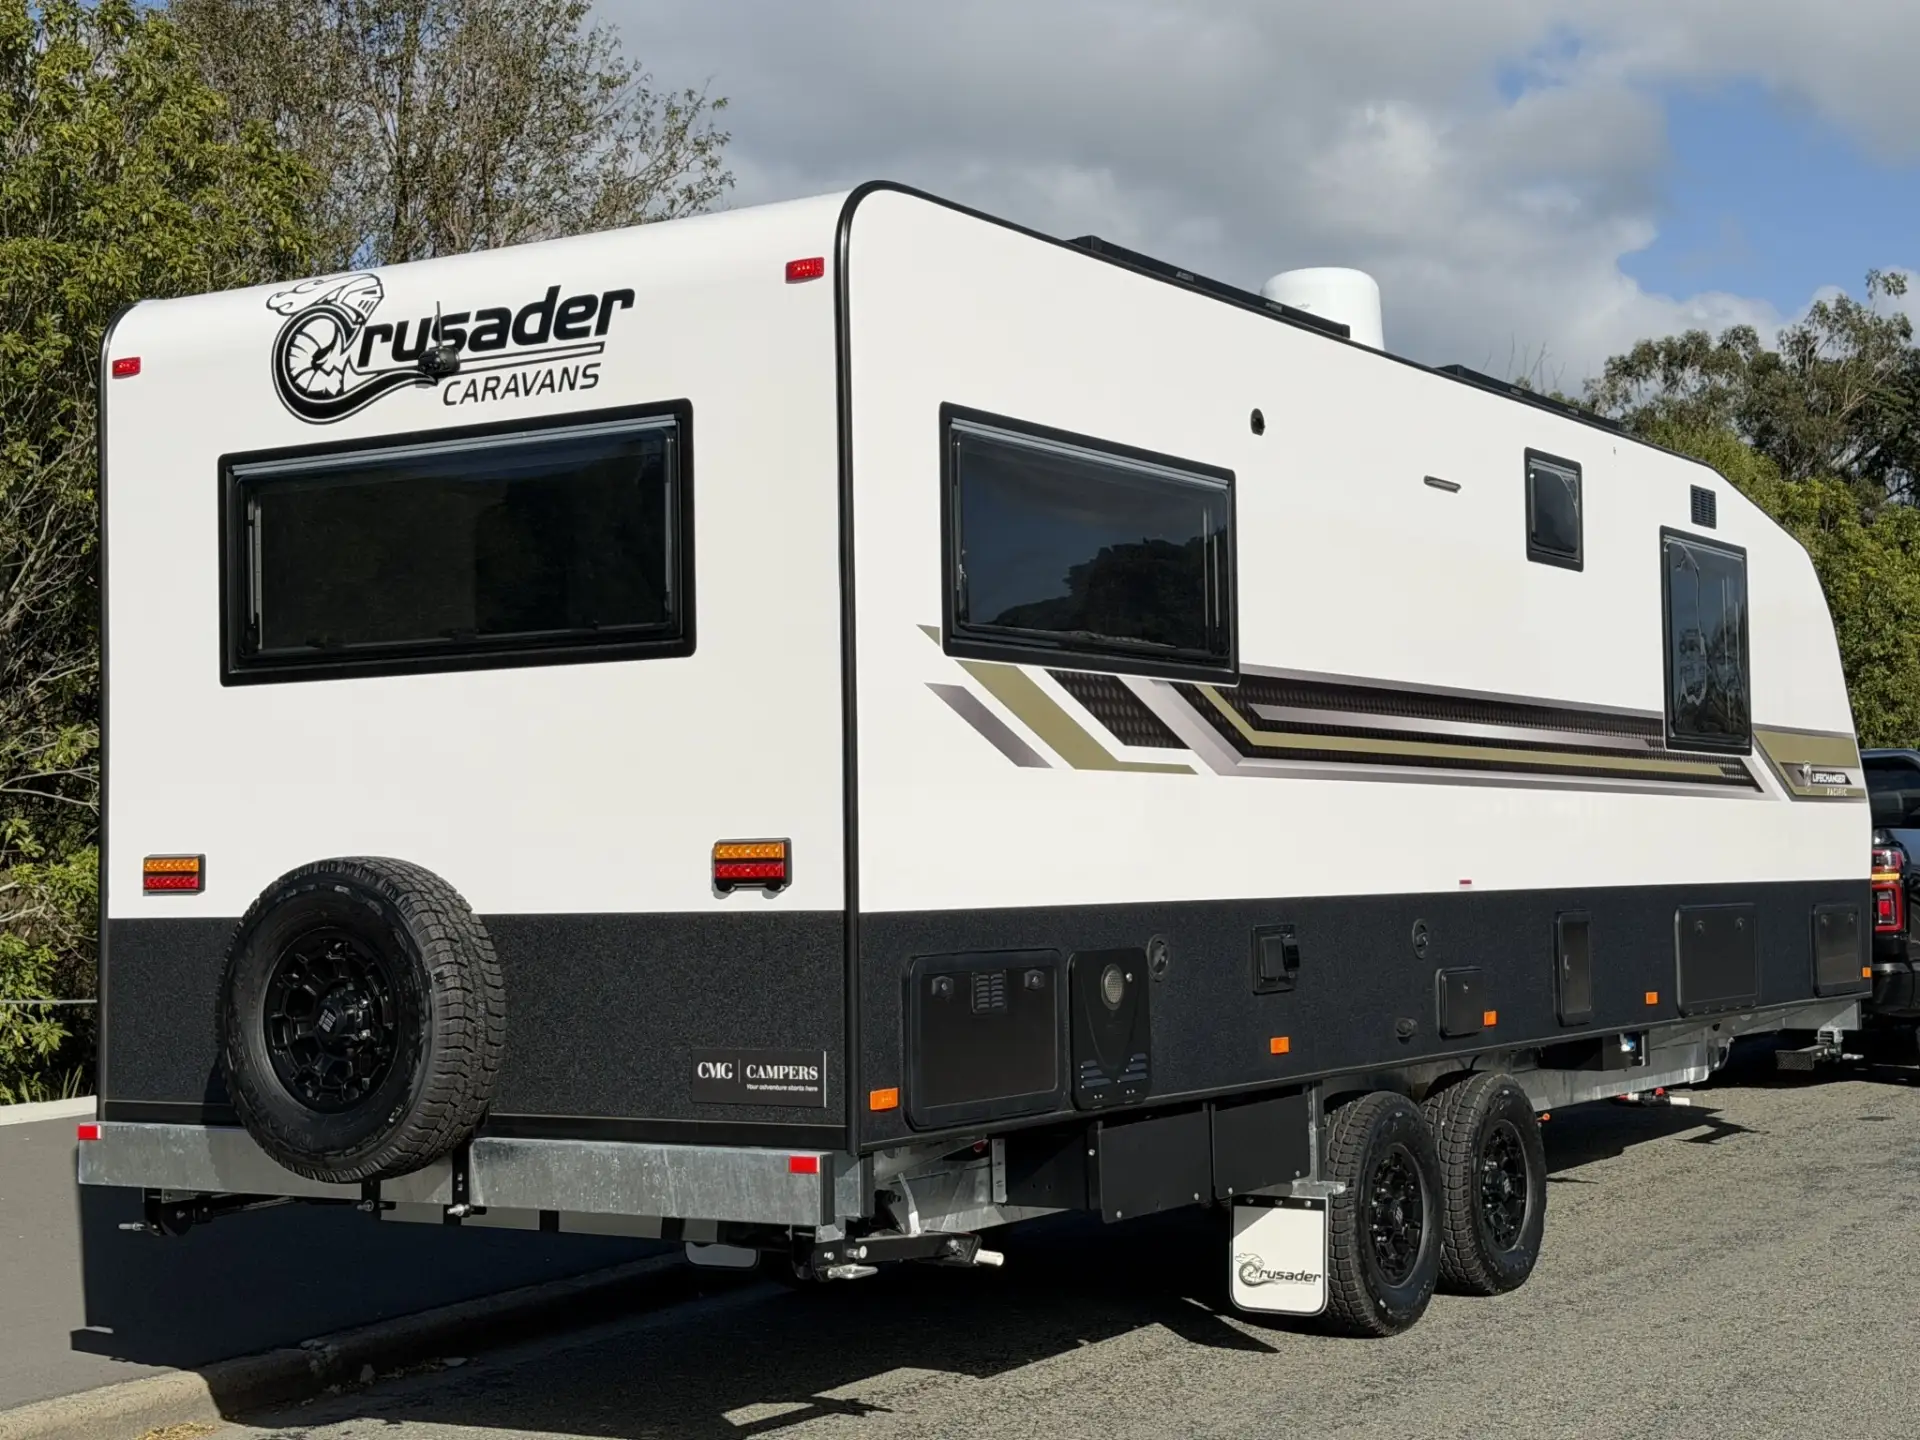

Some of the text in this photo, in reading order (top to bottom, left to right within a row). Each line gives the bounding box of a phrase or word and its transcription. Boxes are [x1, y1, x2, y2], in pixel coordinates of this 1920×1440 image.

[442, 362, 602, 406] CARAVANS
[697, 1061, 818, 1080] CMG CAMPERS
